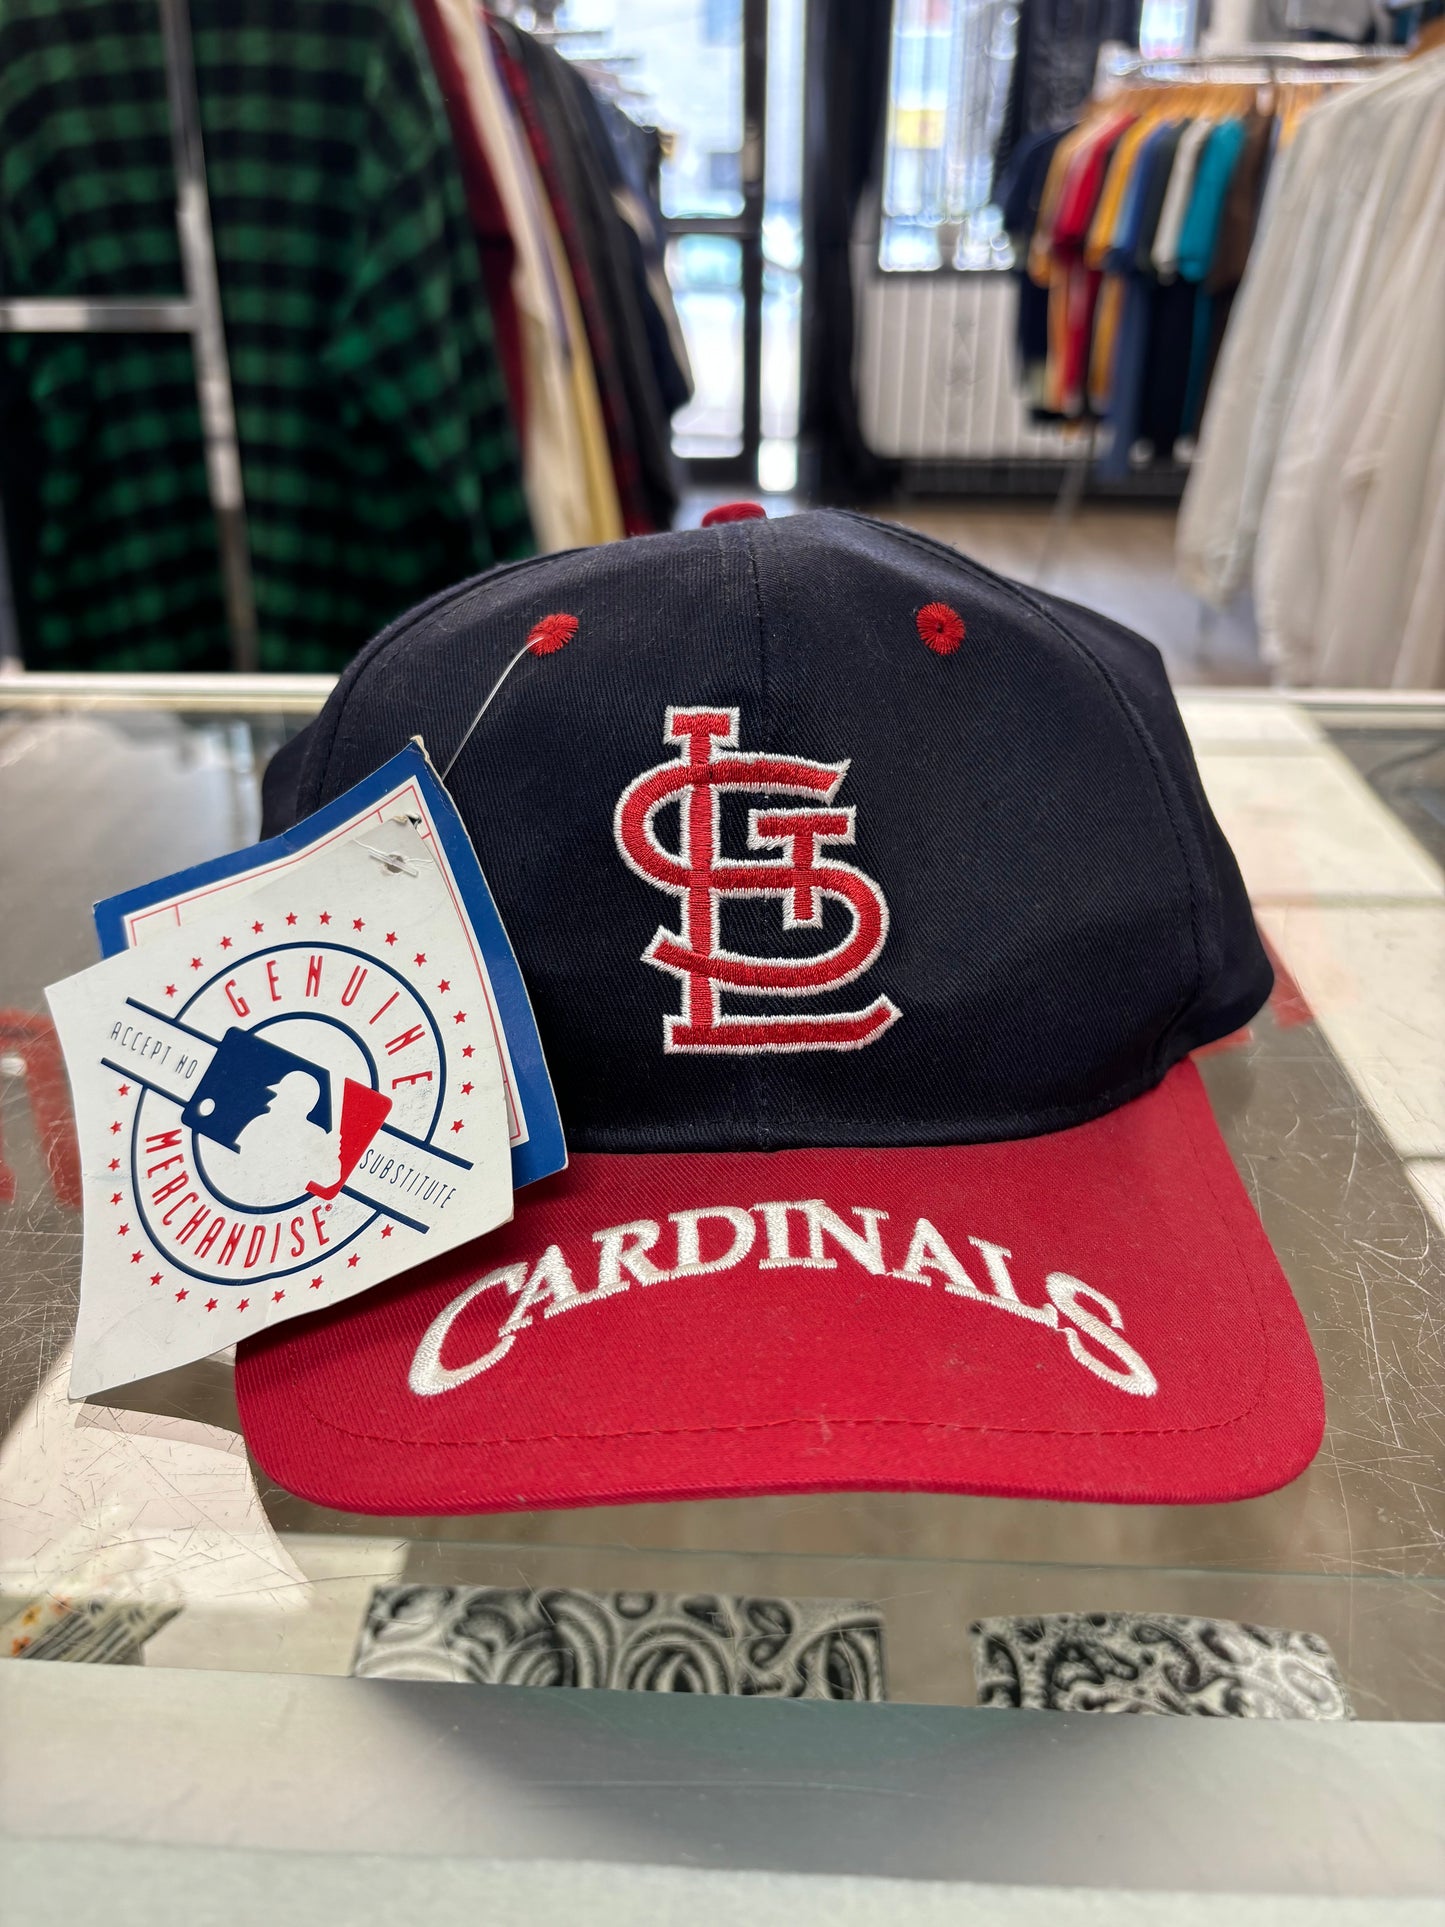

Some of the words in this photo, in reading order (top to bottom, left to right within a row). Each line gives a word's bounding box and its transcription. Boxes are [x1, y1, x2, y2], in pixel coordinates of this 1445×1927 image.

[110, 1021, 172, 1065] ACCEPT
[175, 1050, 199, 1080] NO
[224, 955, 433, 1090] GENUINE
[359, 1149, 457, 1209] SUBSTITUTE
[407, 1199, 1158, 1398] CARDINALS
